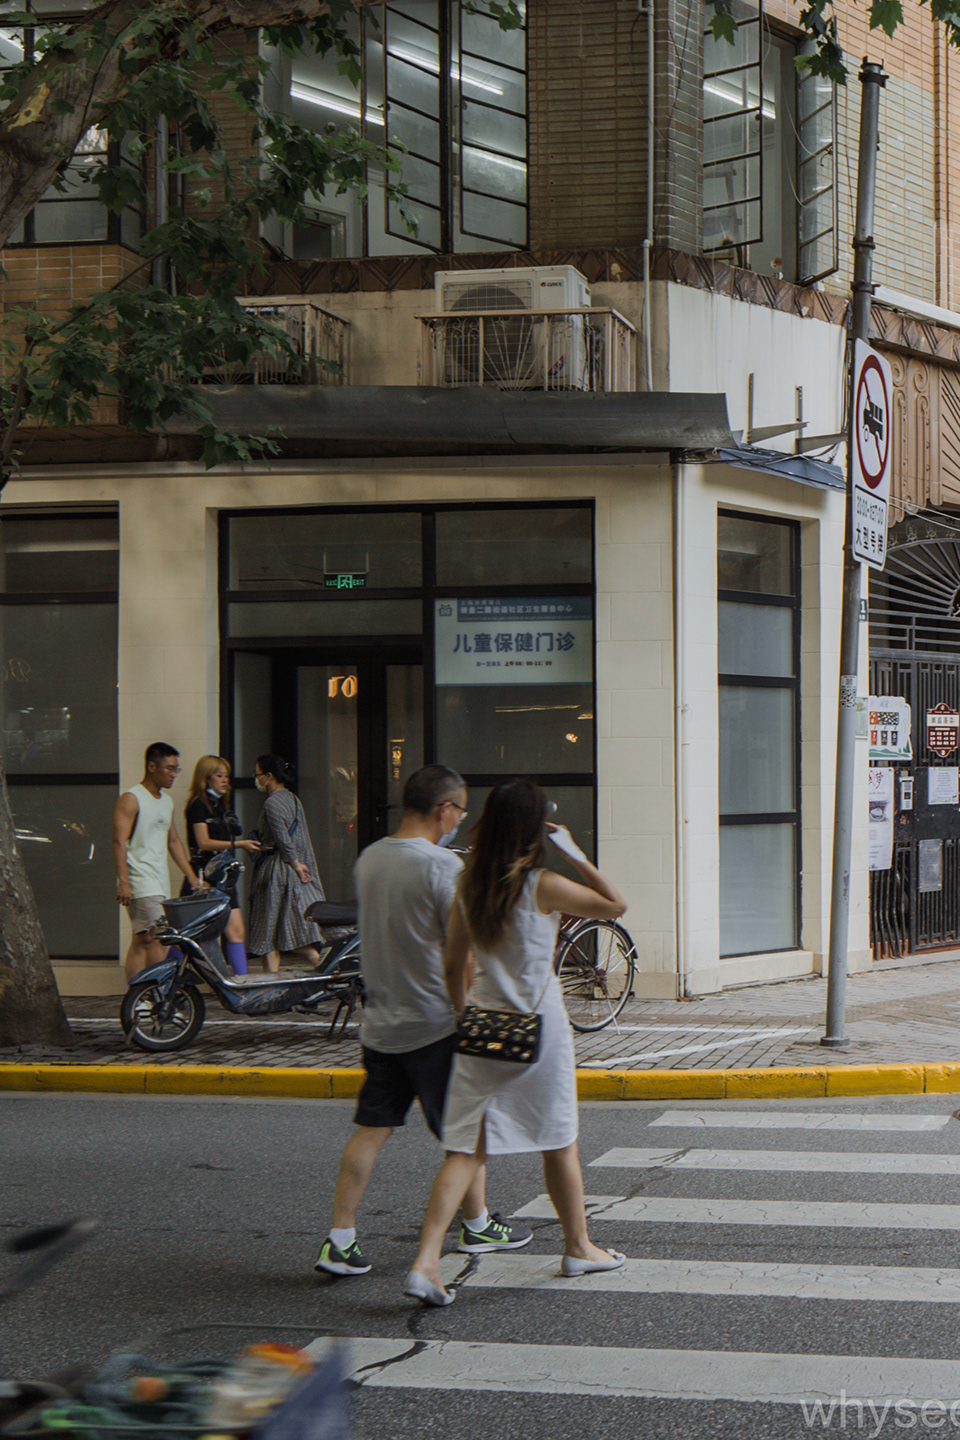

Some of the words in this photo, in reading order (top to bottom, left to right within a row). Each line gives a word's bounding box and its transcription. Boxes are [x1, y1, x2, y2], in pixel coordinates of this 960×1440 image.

[453, 632, 575, 653] 儿童保健门诊
